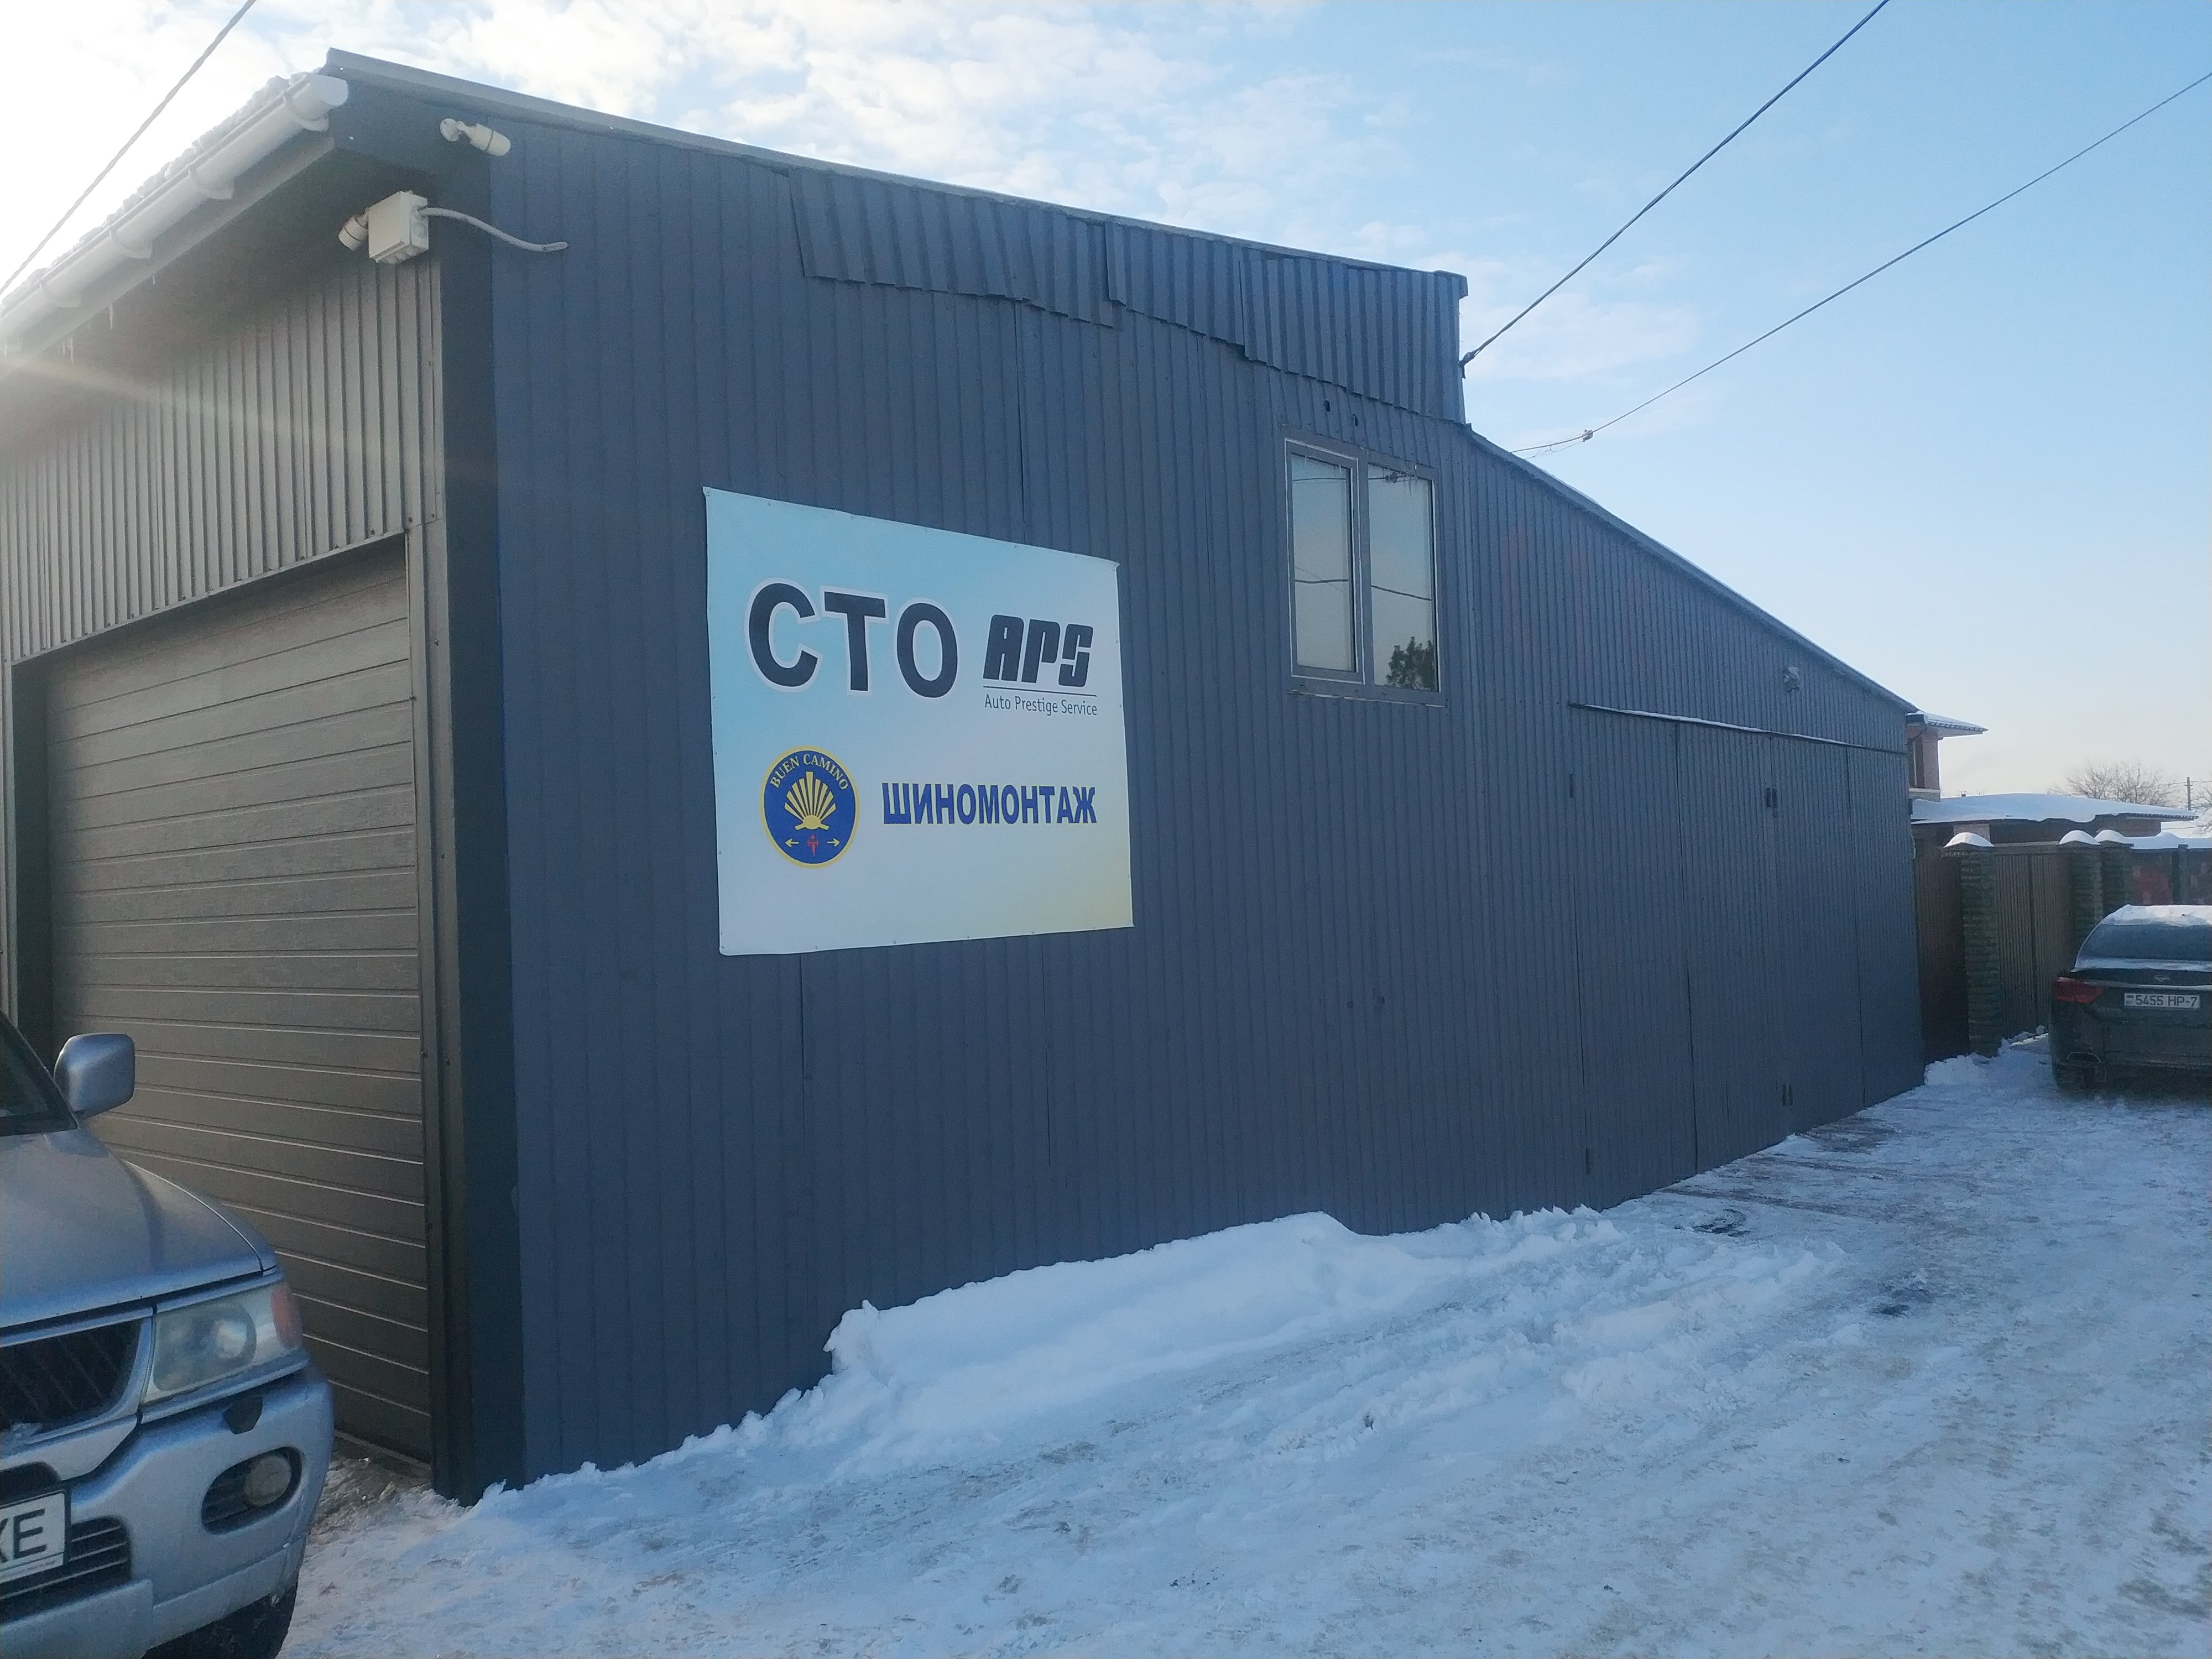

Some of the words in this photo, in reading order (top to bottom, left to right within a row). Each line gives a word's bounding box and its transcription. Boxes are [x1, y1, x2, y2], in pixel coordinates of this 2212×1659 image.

[749, 582, 958, 698] СТО
[982, 614, 1094, 687] APS
[984, 693, 1011, 709] Auto
[1015, 696, 1058, 716] Prestige
[1061, 699, 1097, 716] Service
[770, 756, 800, 789] BUEN
[803, 754, 848, 790] CAMINO
[882, 782, 1097, 824] ШИНОМОНТАЖ
